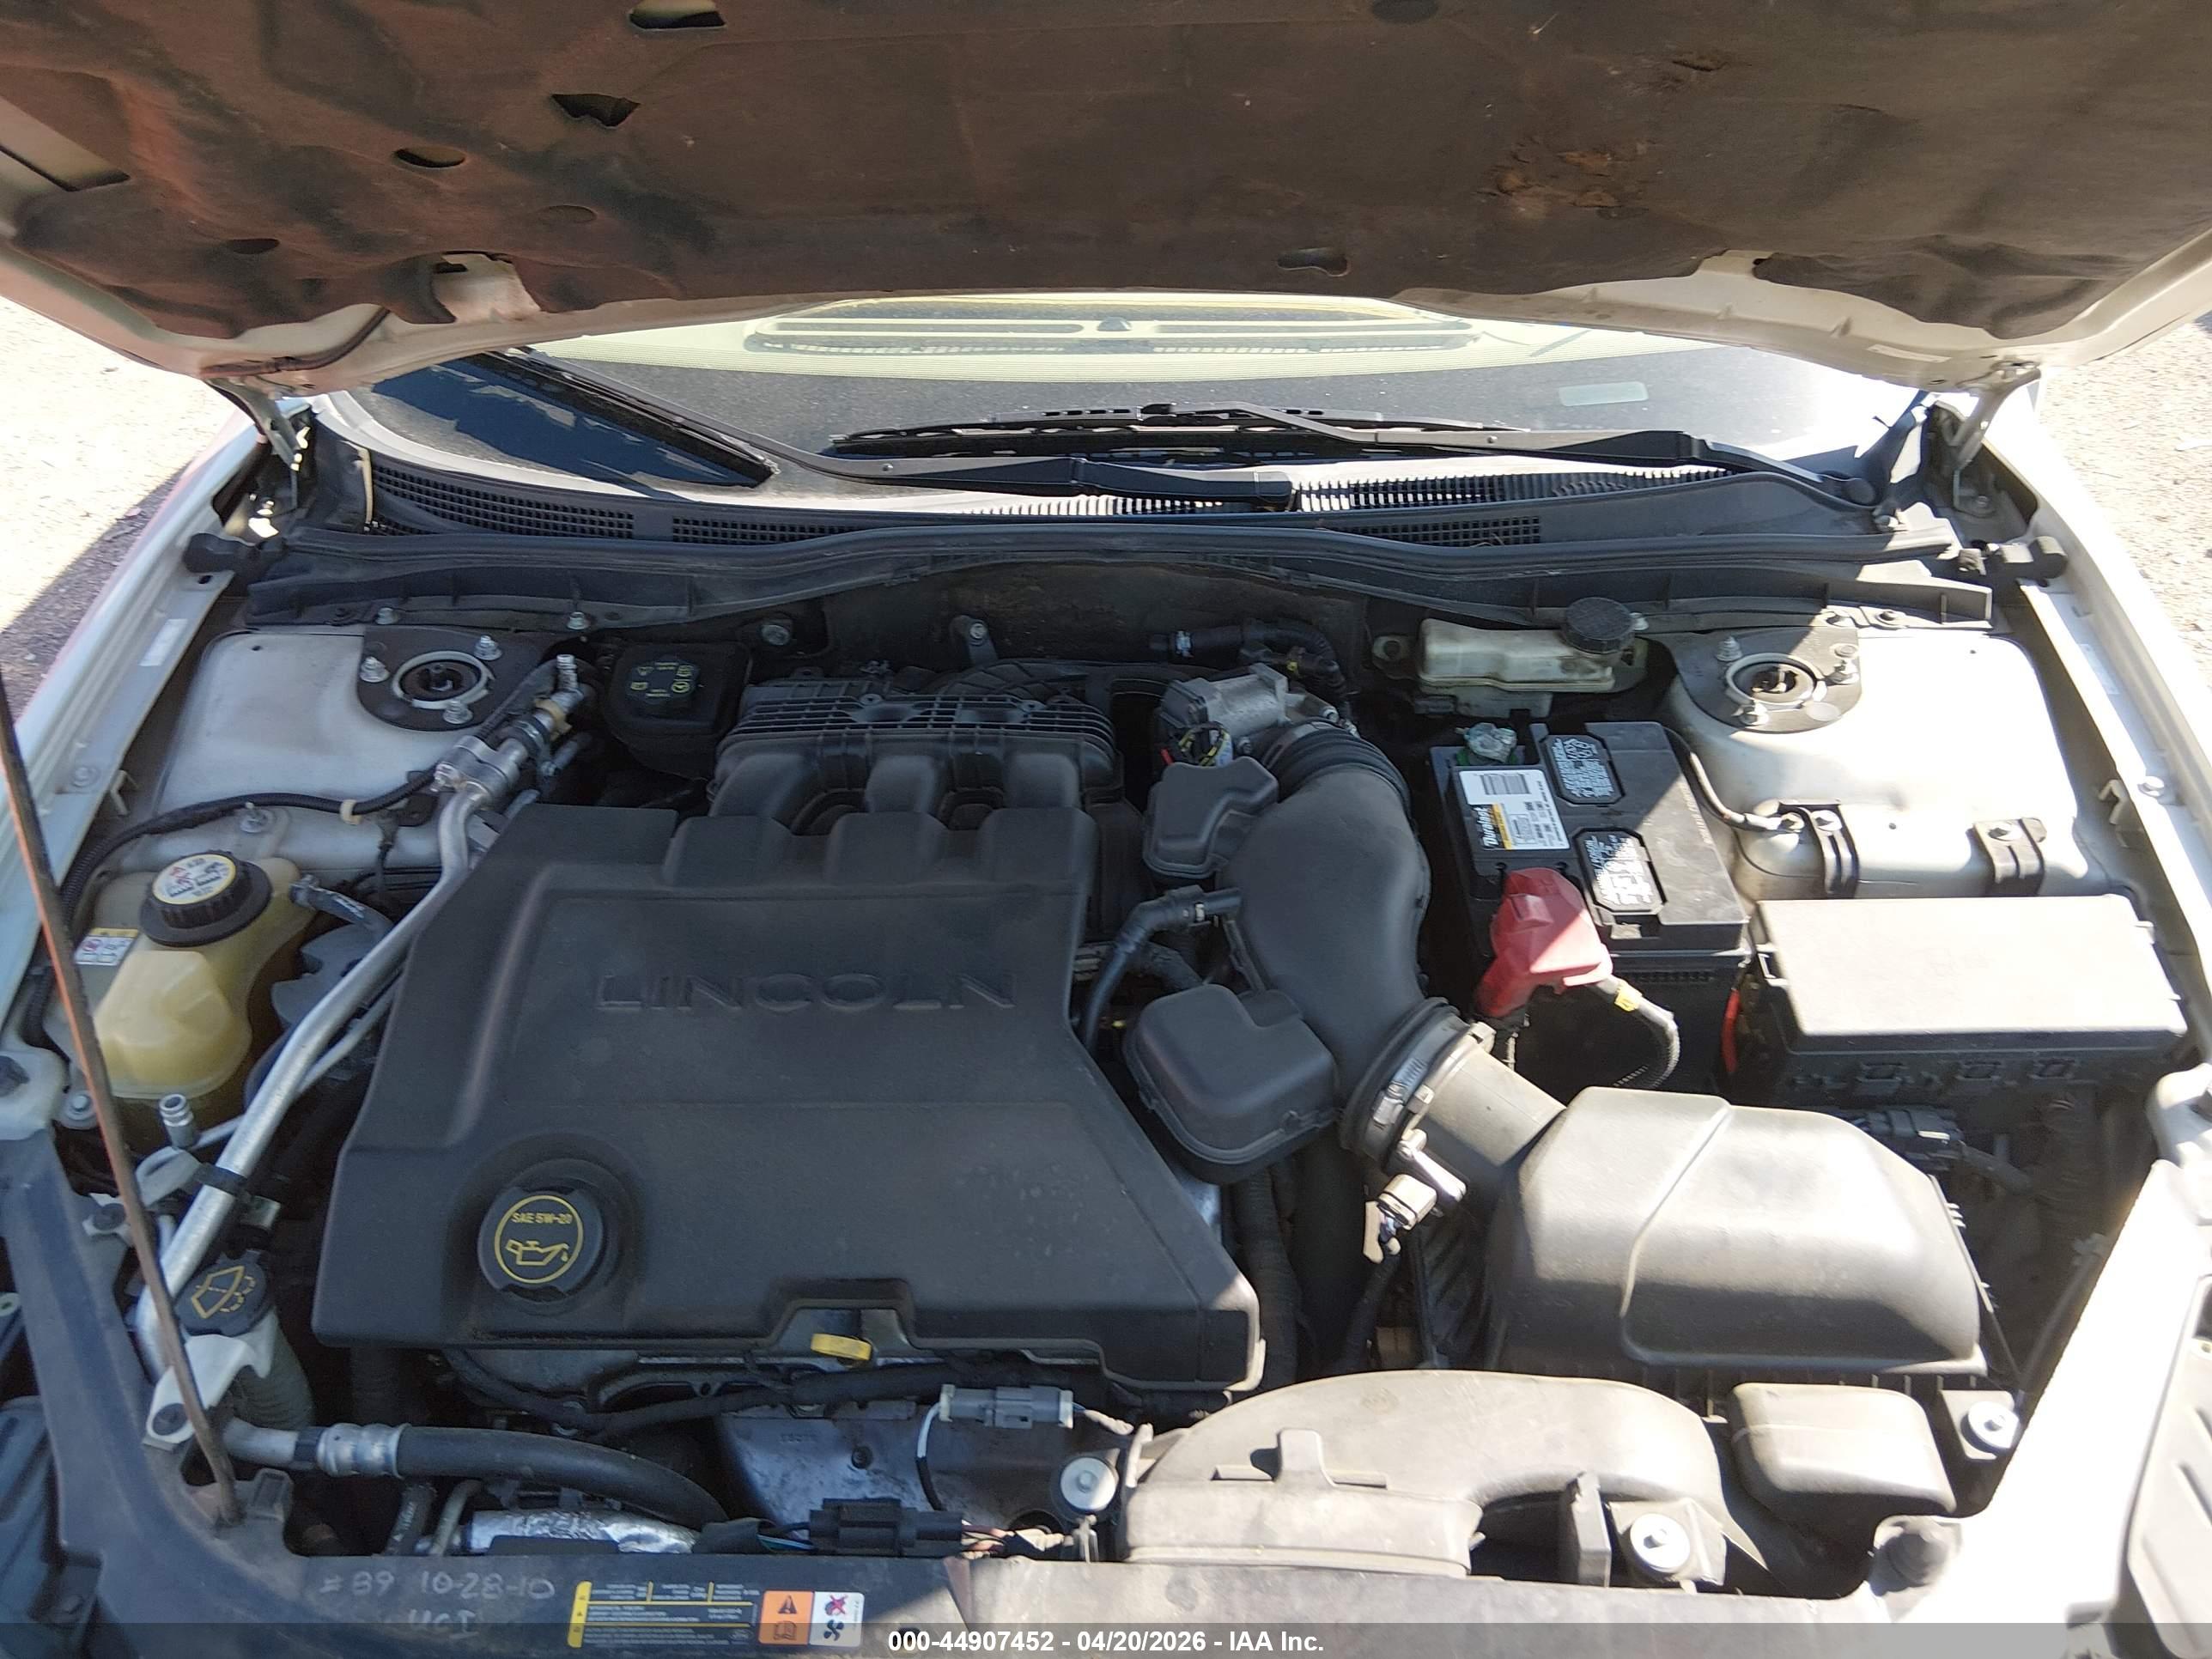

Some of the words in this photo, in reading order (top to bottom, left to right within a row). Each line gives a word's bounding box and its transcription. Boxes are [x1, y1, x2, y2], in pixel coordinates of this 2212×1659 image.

[1473, 805, 1499, 848] Duralast
[597, 973, 1018, 1012] LINCOLN
[511, 1212, 535, 1224] SAE
[535, 1212, 573, 1224] 5W-20
[420, 1570, 556, 1601] 10-28-10
